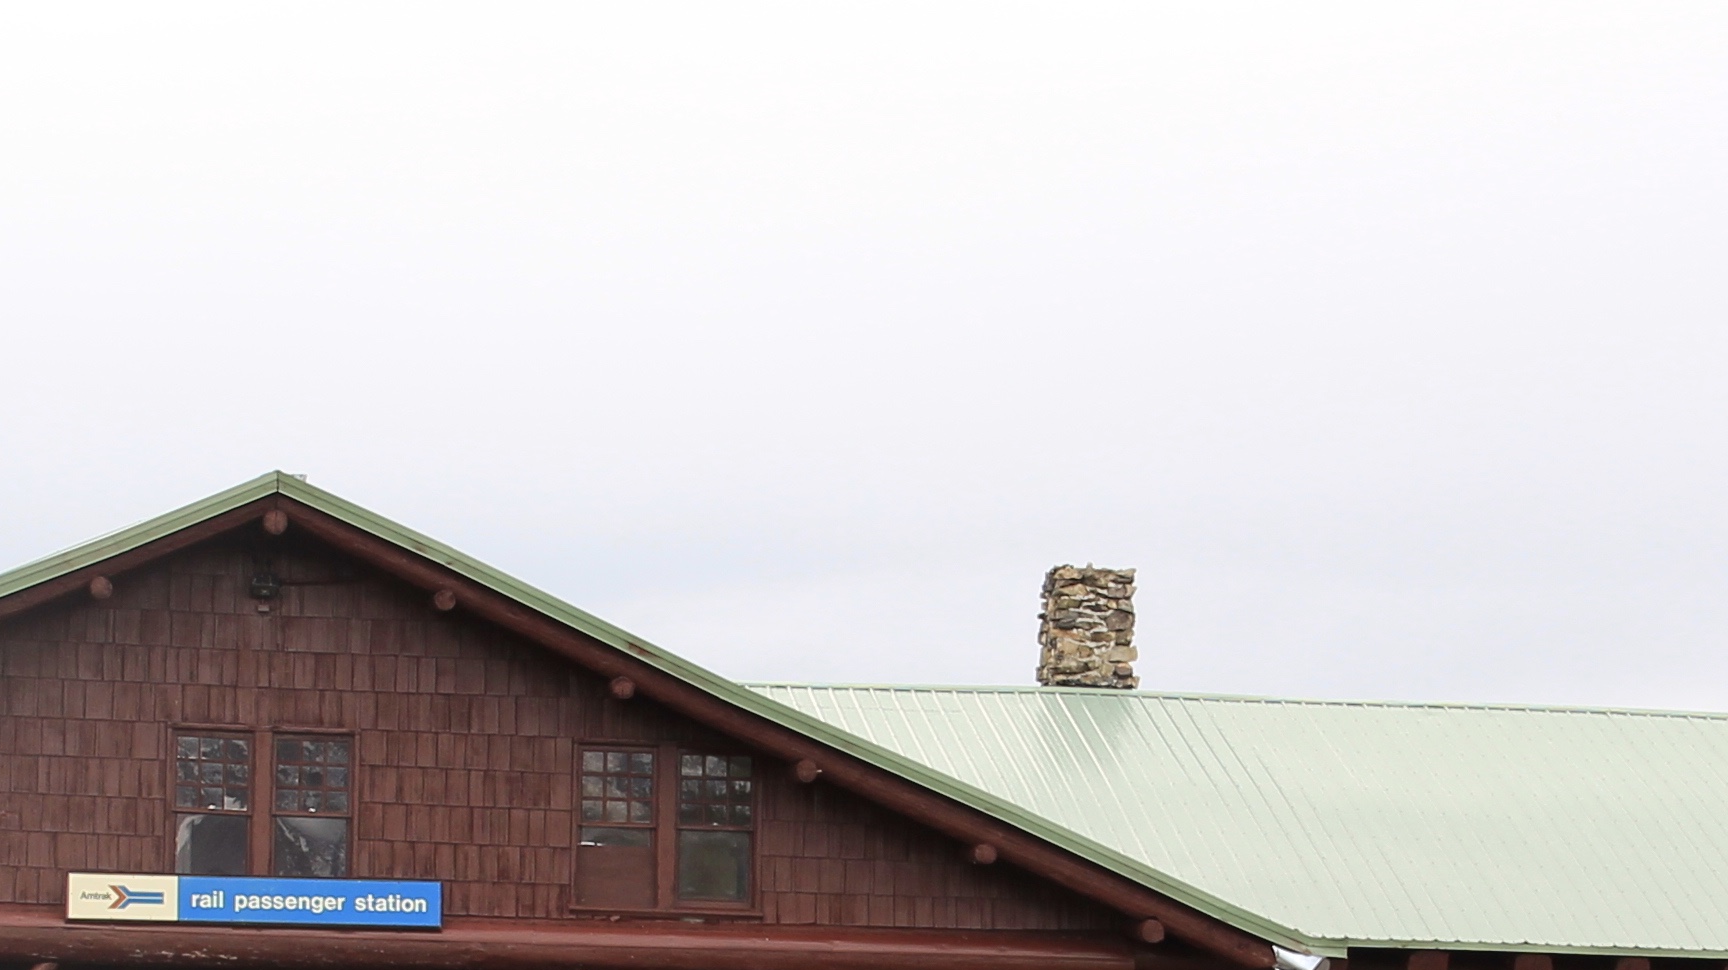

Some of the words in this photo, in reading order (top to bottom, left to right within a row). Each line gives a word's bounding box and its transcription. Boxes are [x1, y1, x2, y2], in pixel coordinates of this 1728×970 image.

[80, 891, 112, 900] Amtrak
[191, 890, 224, 909] rail
[234, 894, 346, 914] passenger
[354, 894, 427, 912] station
